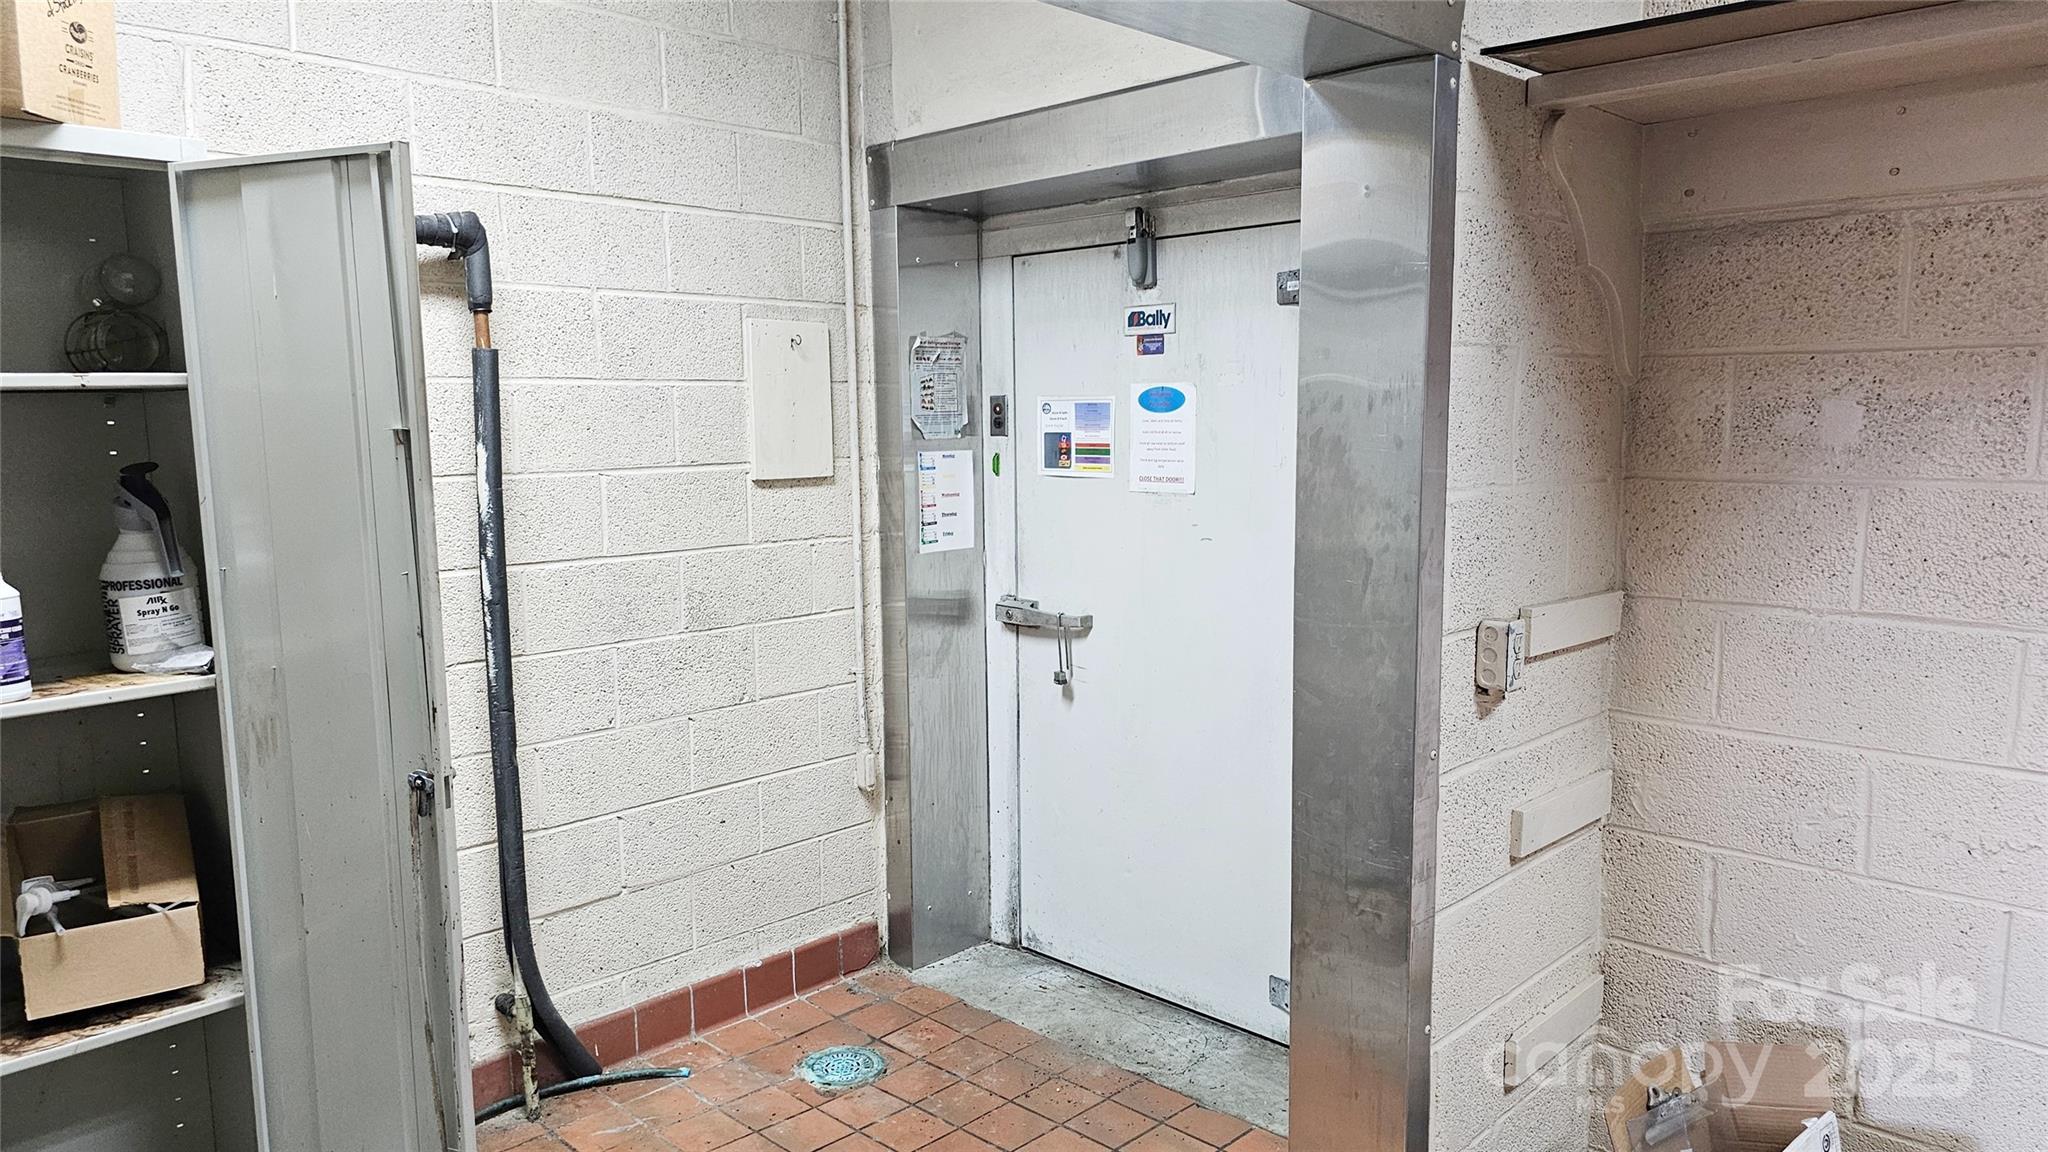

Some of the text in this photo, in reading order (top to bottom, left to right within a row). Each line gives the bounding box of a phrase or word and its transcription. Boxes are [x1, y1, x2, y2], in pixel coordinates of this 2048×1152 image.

[59, 63, 99, 84] CRANBERRIES
[1137, 309, 1171, 329] Bally
[107, 577, 183, 592] PROFESSIONAL
[136, 608, 160, 618] Spray
[169, 604, 180, 612] Go
[107, 598, 125, 655] SPRAYER
